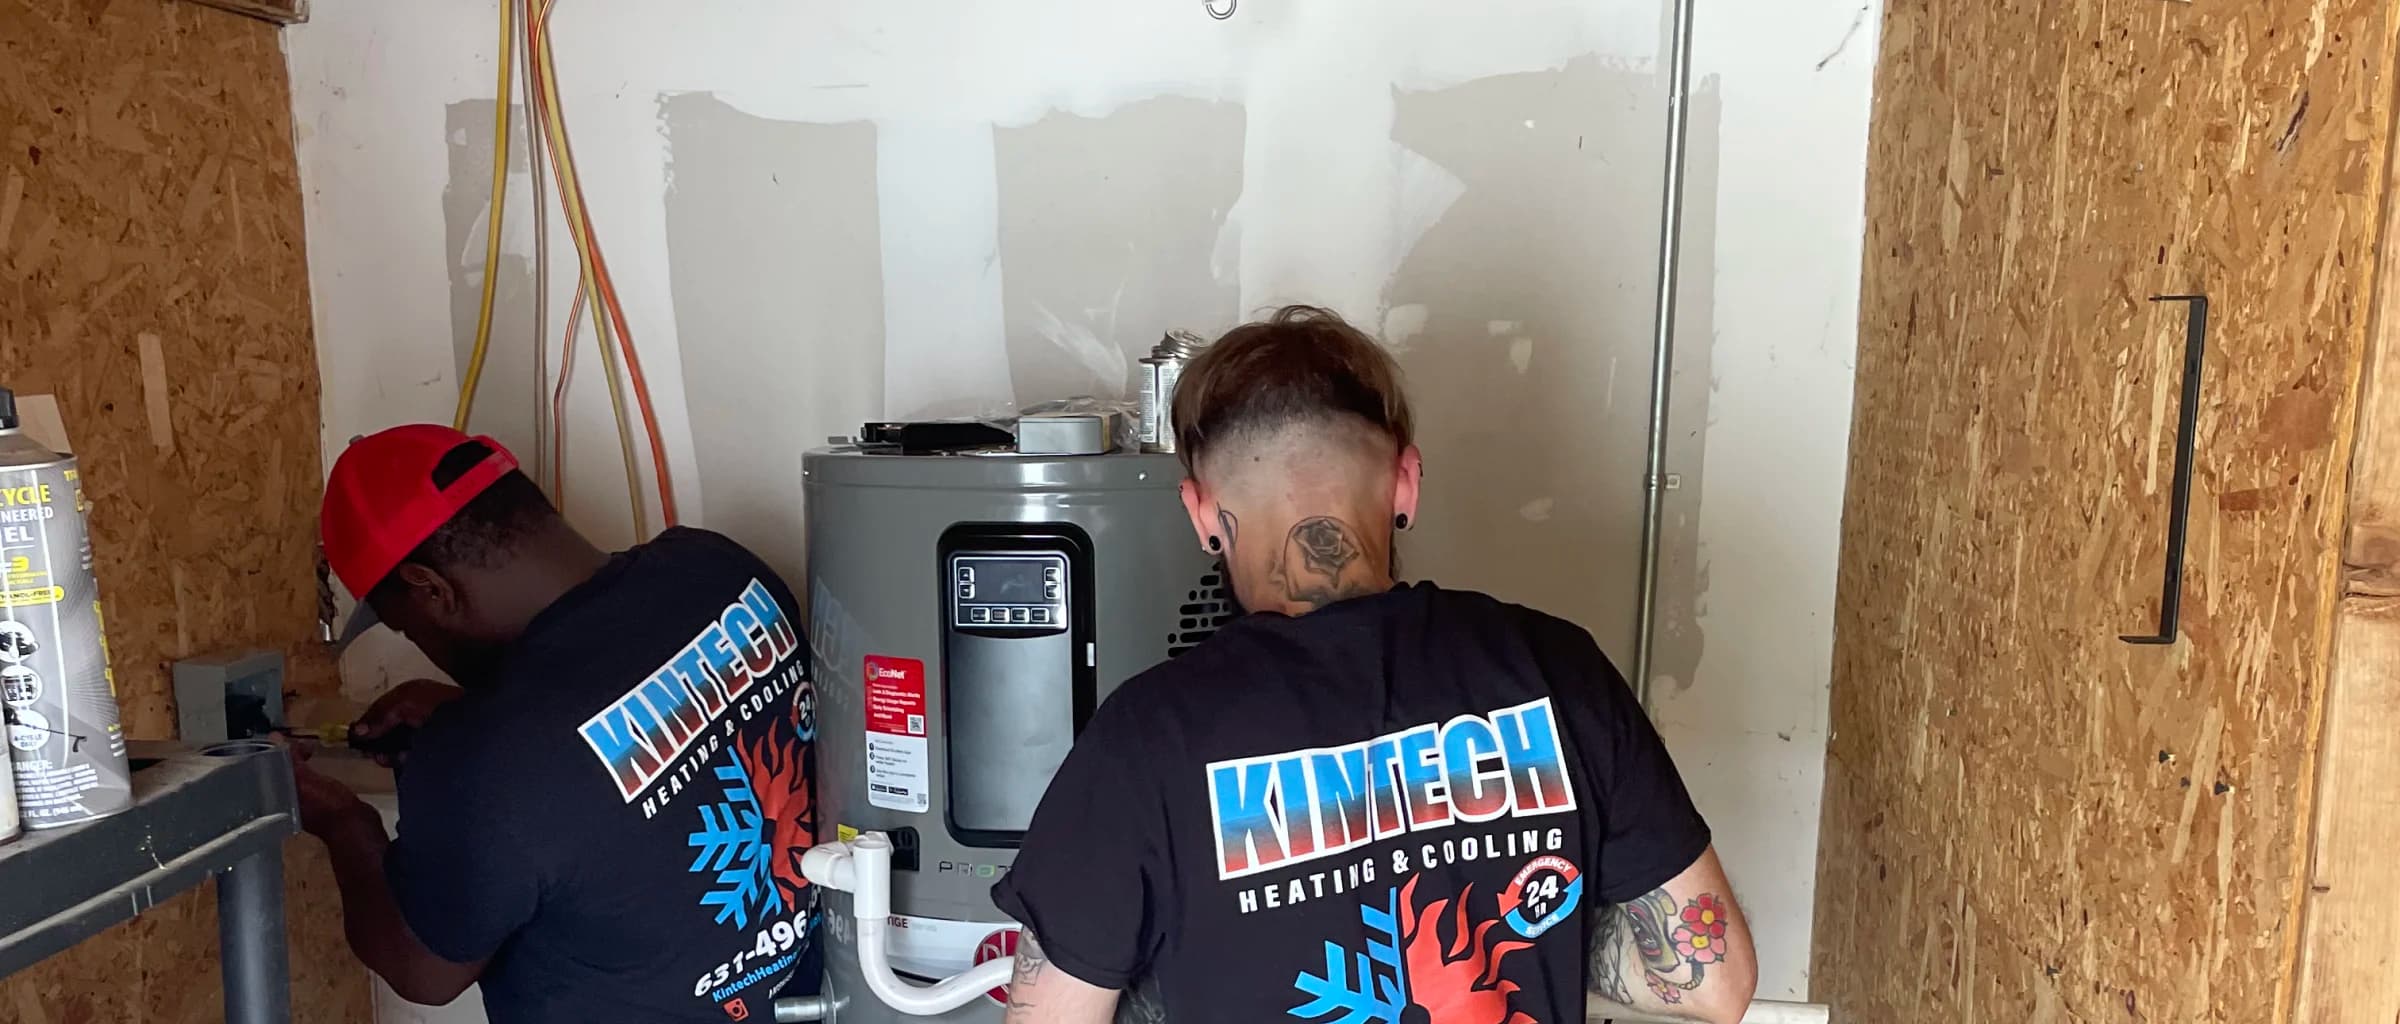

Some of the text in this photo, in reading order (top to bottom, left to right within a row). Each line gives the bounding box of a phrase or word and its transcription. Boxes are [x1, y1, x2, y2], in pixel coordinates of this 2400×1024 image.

[0, 484, 52, 508] YCLE
[1, 525, 35, 543] EL
[577, 577, 798, 804] KINTECH
[878, 667, 906, 680] EcoNet
[642, 735, 720, 820] HEATING
[723, 718, 736, 737] &
[738, 659, 806, 723] COOLING
[1206, 697, 1577, 880] KINTECH
[1239, 828, 1563, 914] HEATING & COOLING
[1513, 857, 1573, 887] EMERGENCY
[1526, 875, 1559, 909] 24
